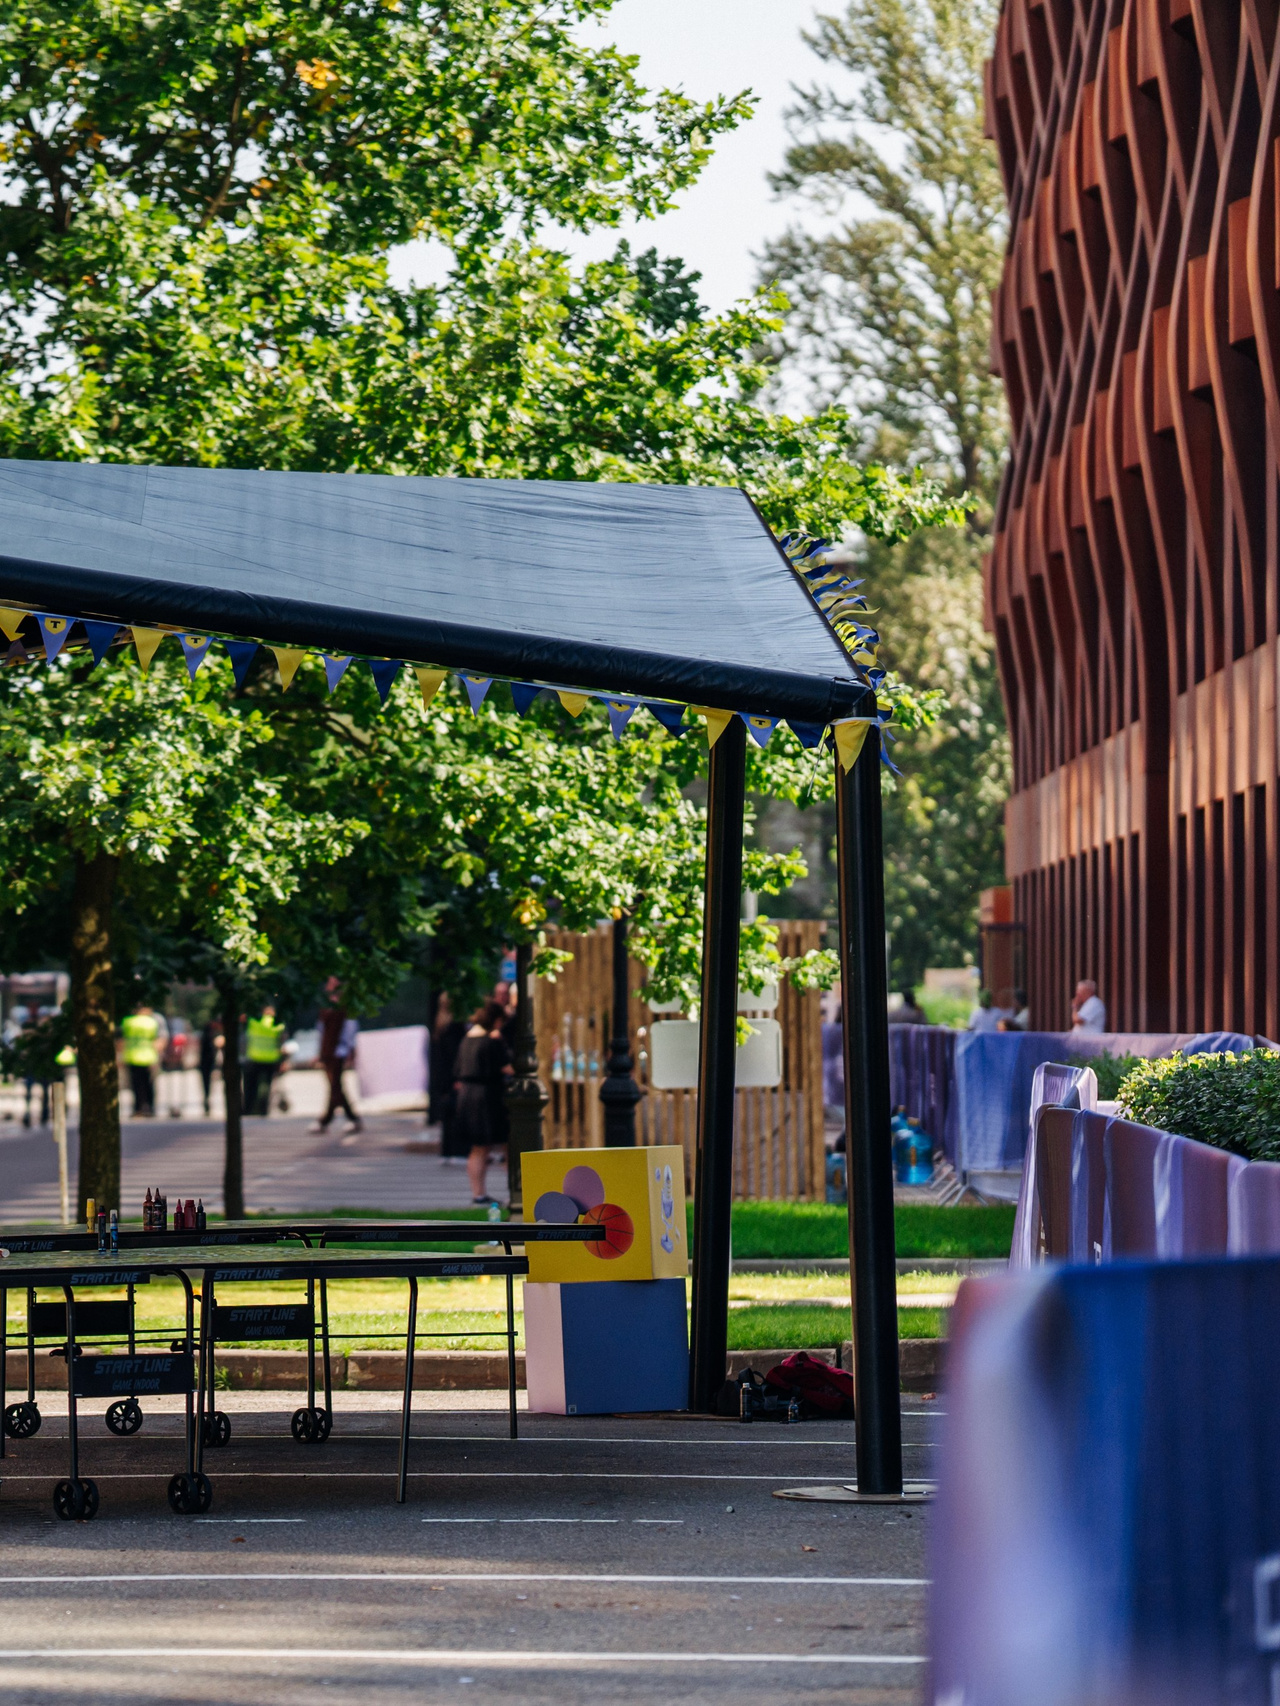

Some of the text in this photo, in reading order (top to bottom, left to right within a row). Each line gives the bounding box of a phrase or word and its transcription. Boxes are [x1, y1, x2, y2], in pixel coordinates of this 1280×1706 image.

[535, 1231, 594, 1240] START LINE
[213, 1268, 282, 1281] START LINE
[441, 1263, 485, 1274] GAME INDOOR
[70, 1270, 140, 1284] START LINE
[229, 1308, 297, 1322] START LINE
[93, 1358, 172, 1375] START LINE
[112, 1378, 161, 1391] GAME INDOOR
